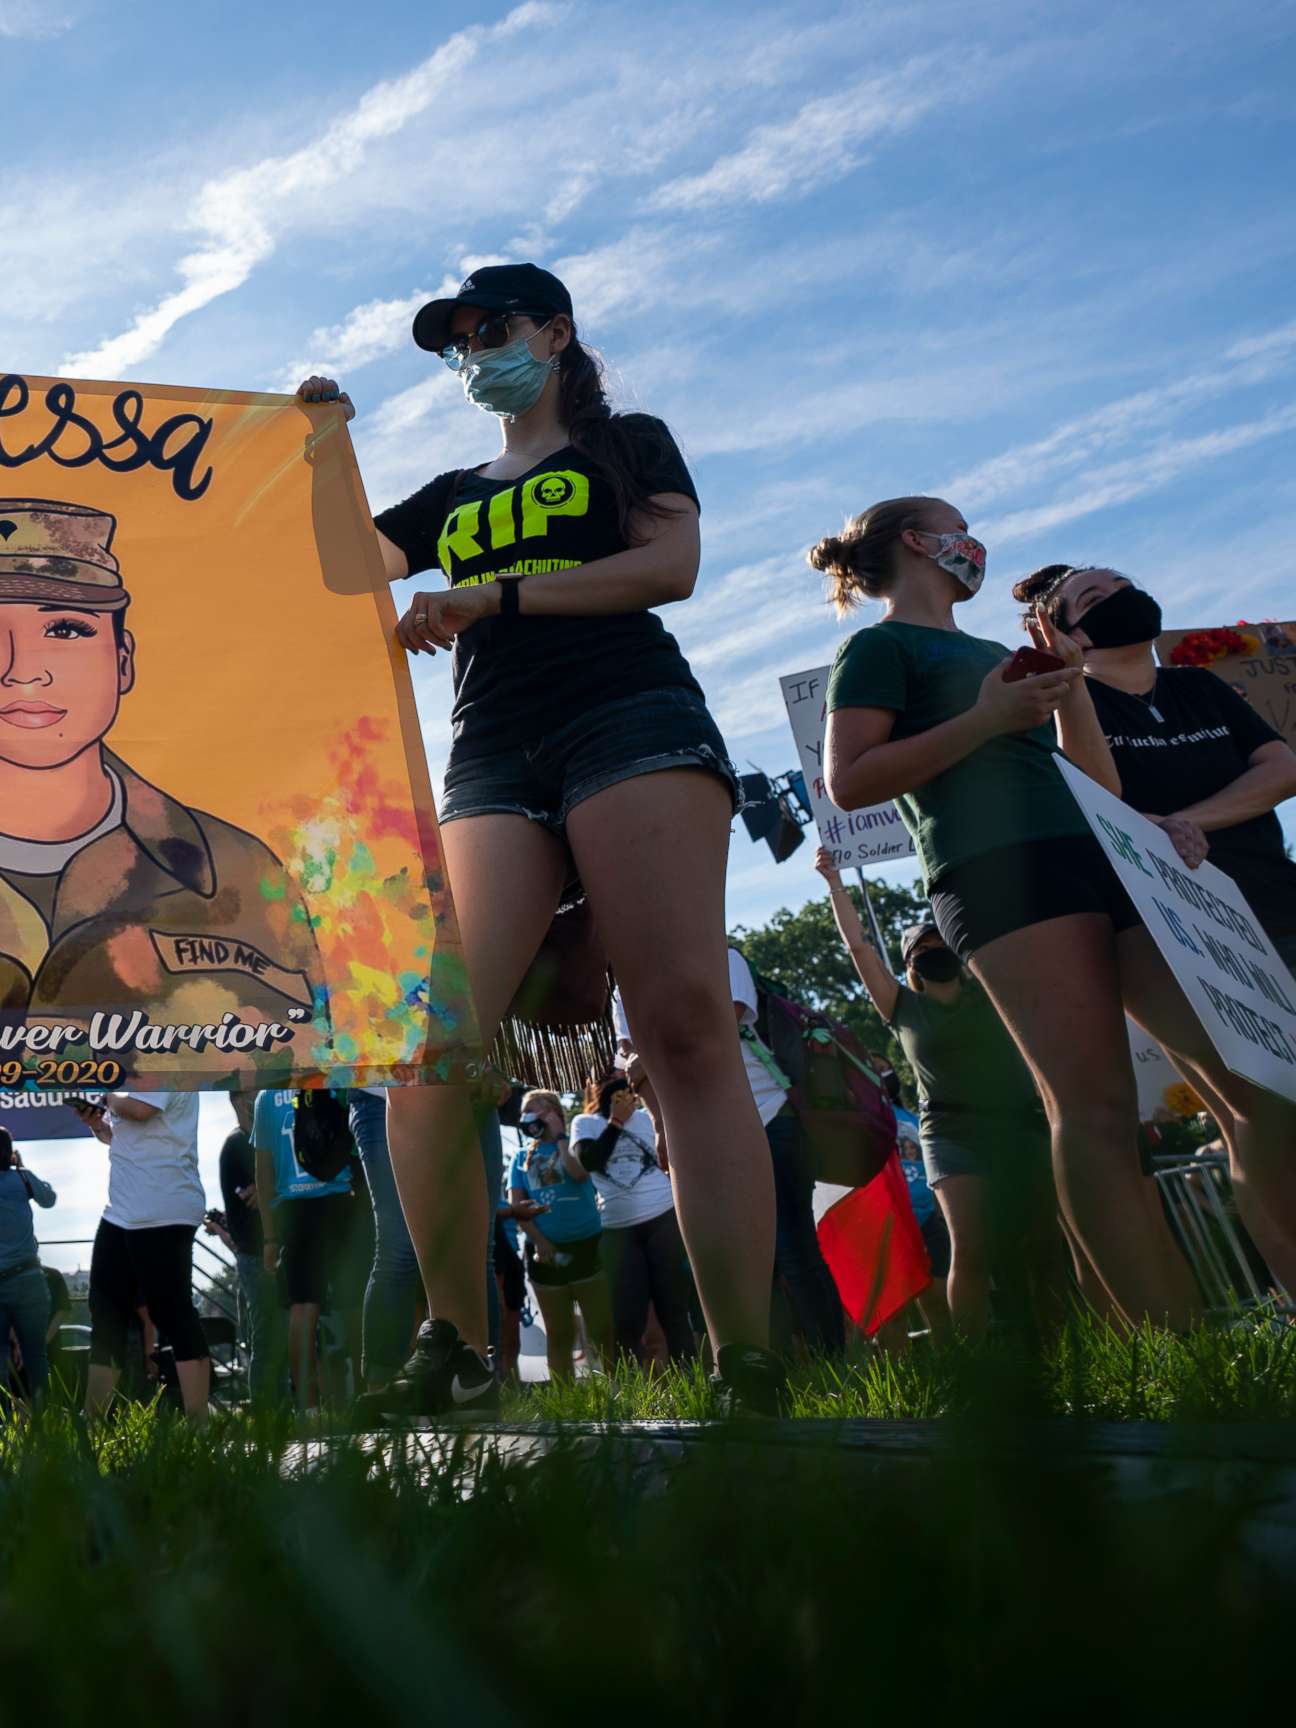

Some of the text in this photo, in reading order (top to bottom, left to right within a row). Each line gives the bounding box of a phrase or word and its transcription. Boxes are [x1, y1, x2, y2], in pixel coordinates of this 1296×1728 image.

[437, 469, 590, 578] RIP
[789, 678, 820, 705] IF
[858, 842, 903, 860] Soldier
[174, 938, 272, 976] FIND ME
[1197, 975, 1293, 1065] PROTECT
